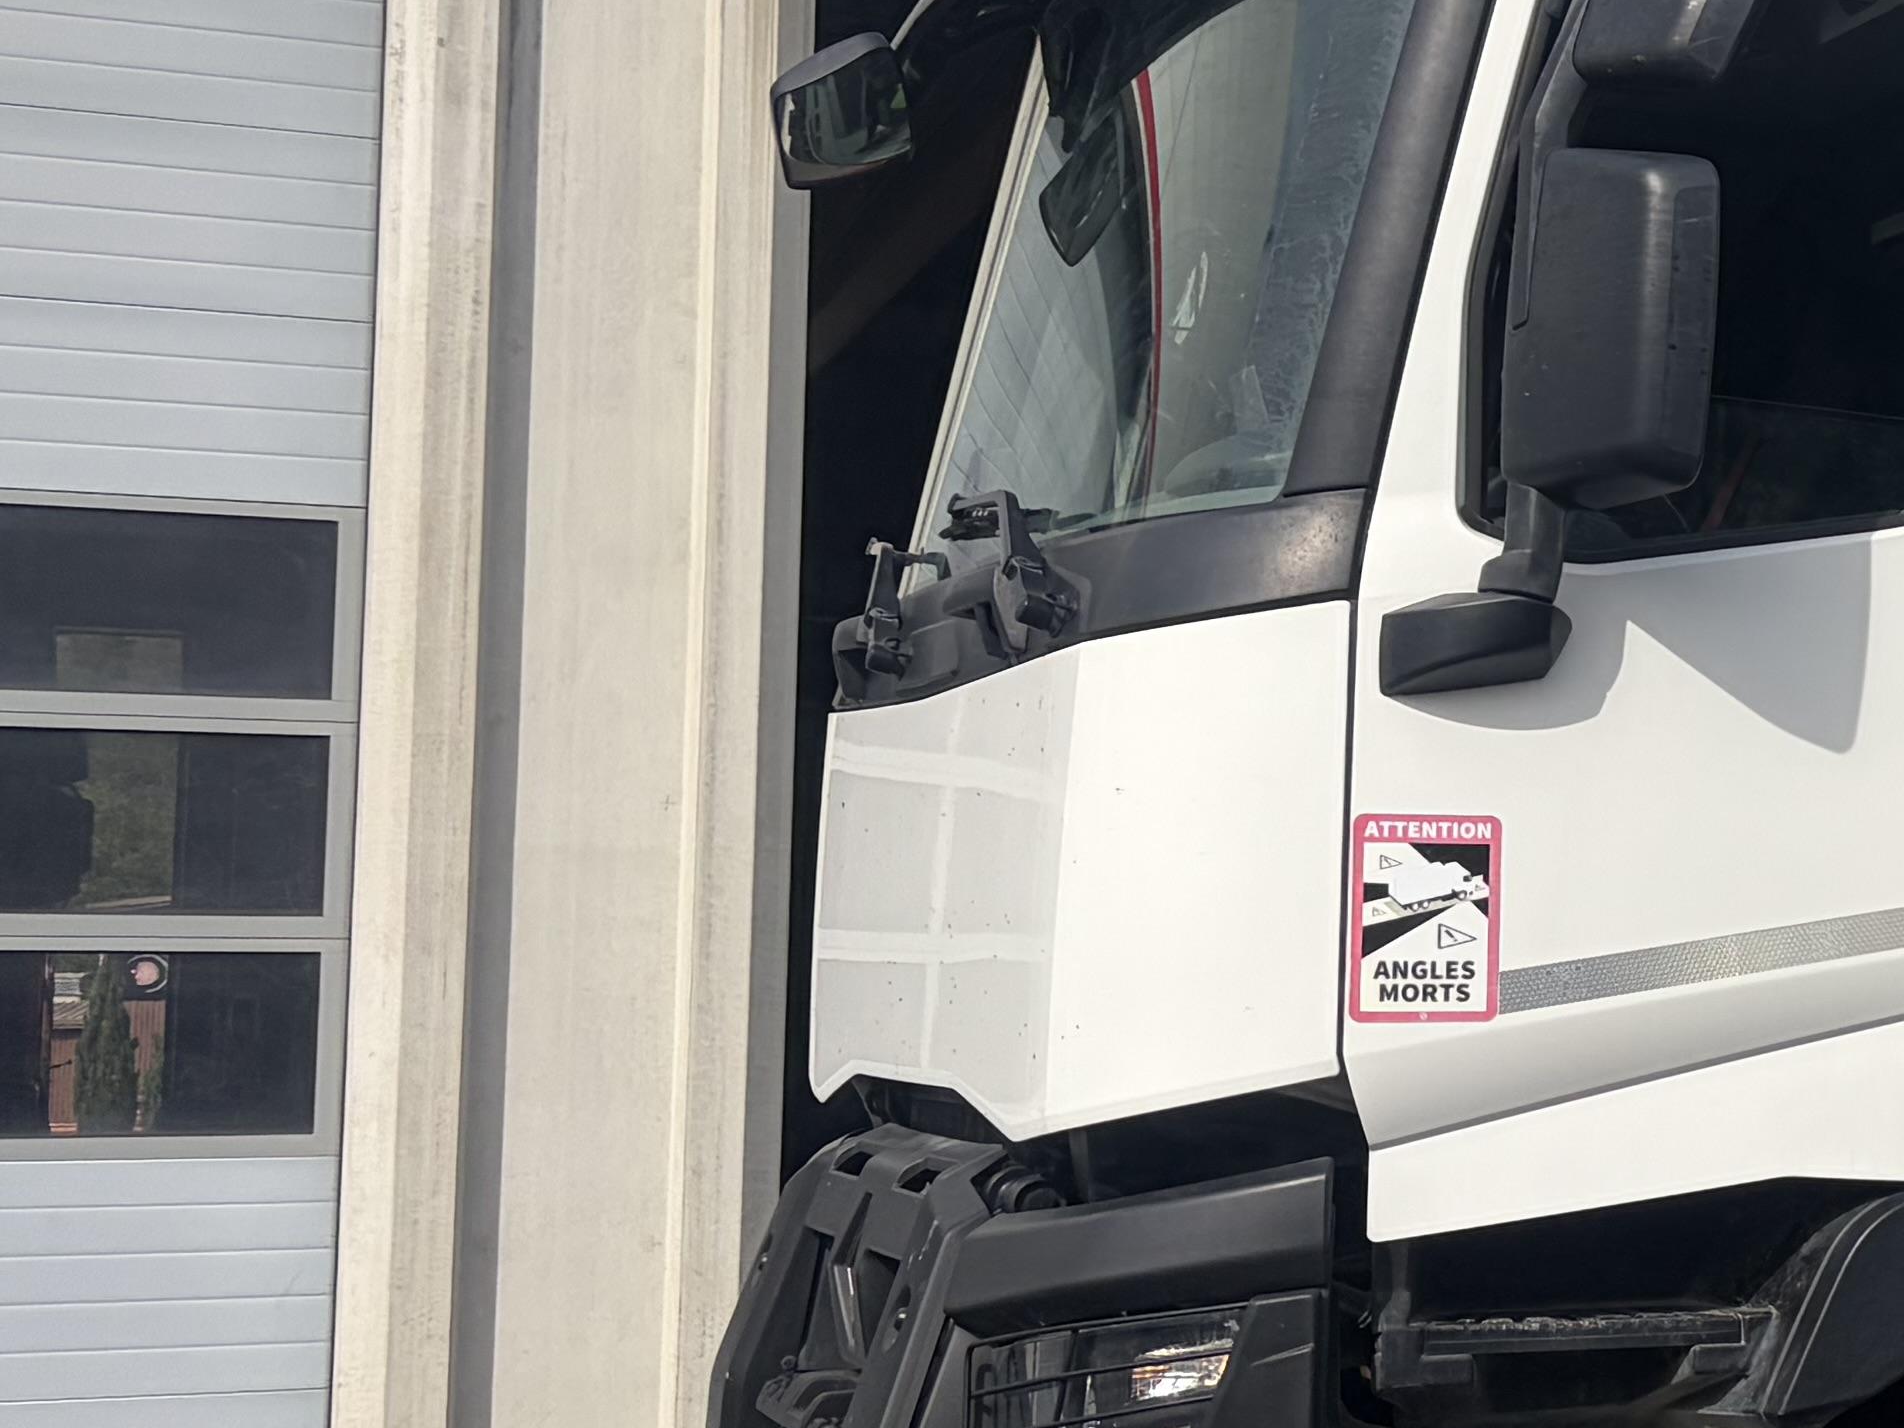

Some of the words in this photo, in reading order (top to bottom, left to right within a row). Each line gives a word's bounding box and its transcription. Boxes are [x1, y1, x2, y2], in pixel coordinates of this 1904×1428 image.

[1364, 820, 1492, 839] ATTENTION
[1373, 960, 1475, 980] ANGLES
[1379, 983, 1470, 1003] MORTS
